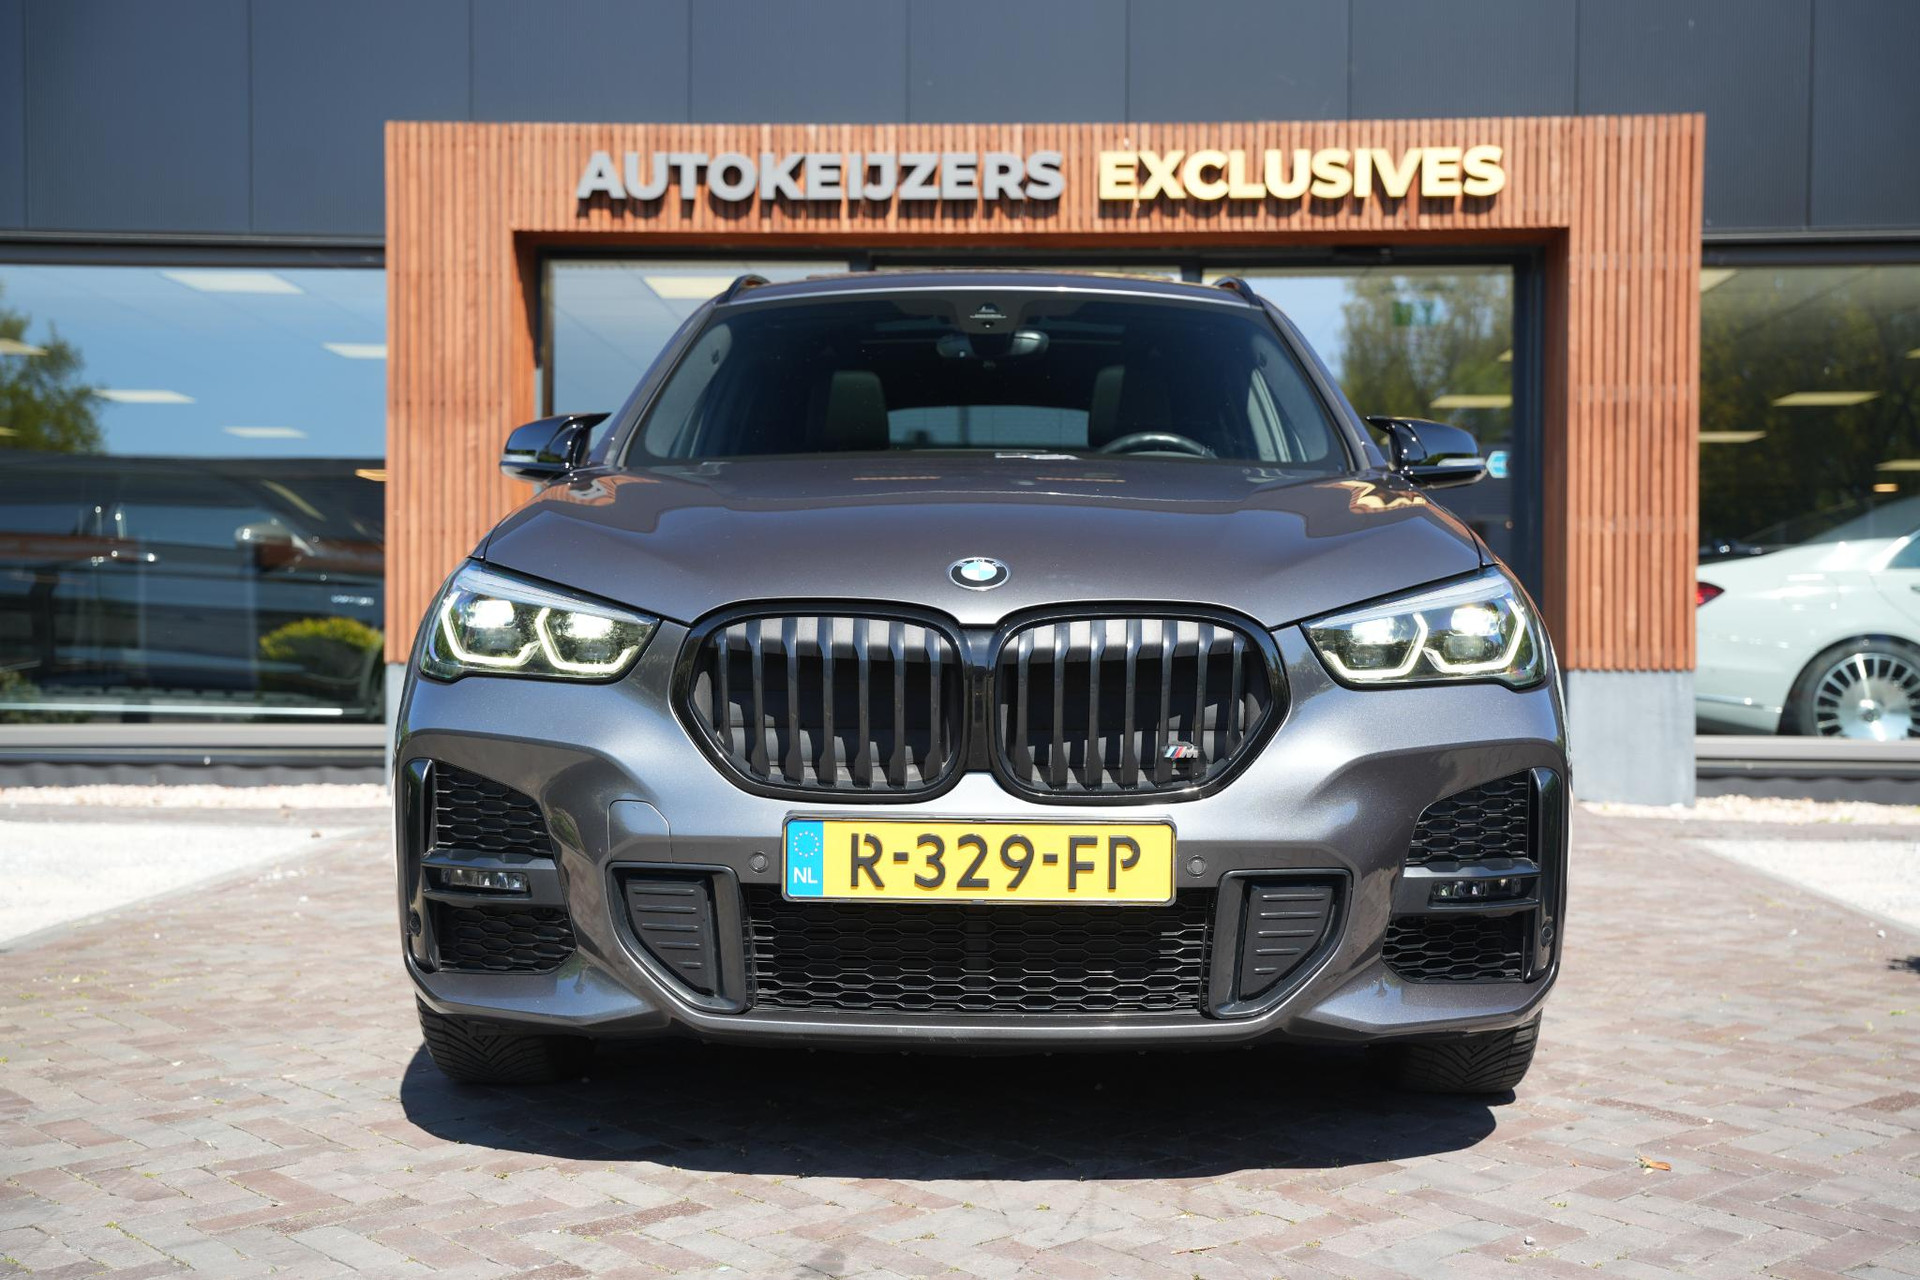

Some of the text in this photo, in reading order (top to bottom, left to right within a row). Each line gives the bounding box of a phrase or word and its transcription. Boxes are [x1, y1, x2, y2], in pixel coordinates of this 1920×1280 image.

[576, 145, 1506, 201] AUTOKEIJZERS EXCLUSIVES
[793, 867, 818, 884] NL
[850, 832, 1141, 890] R-329-FP
